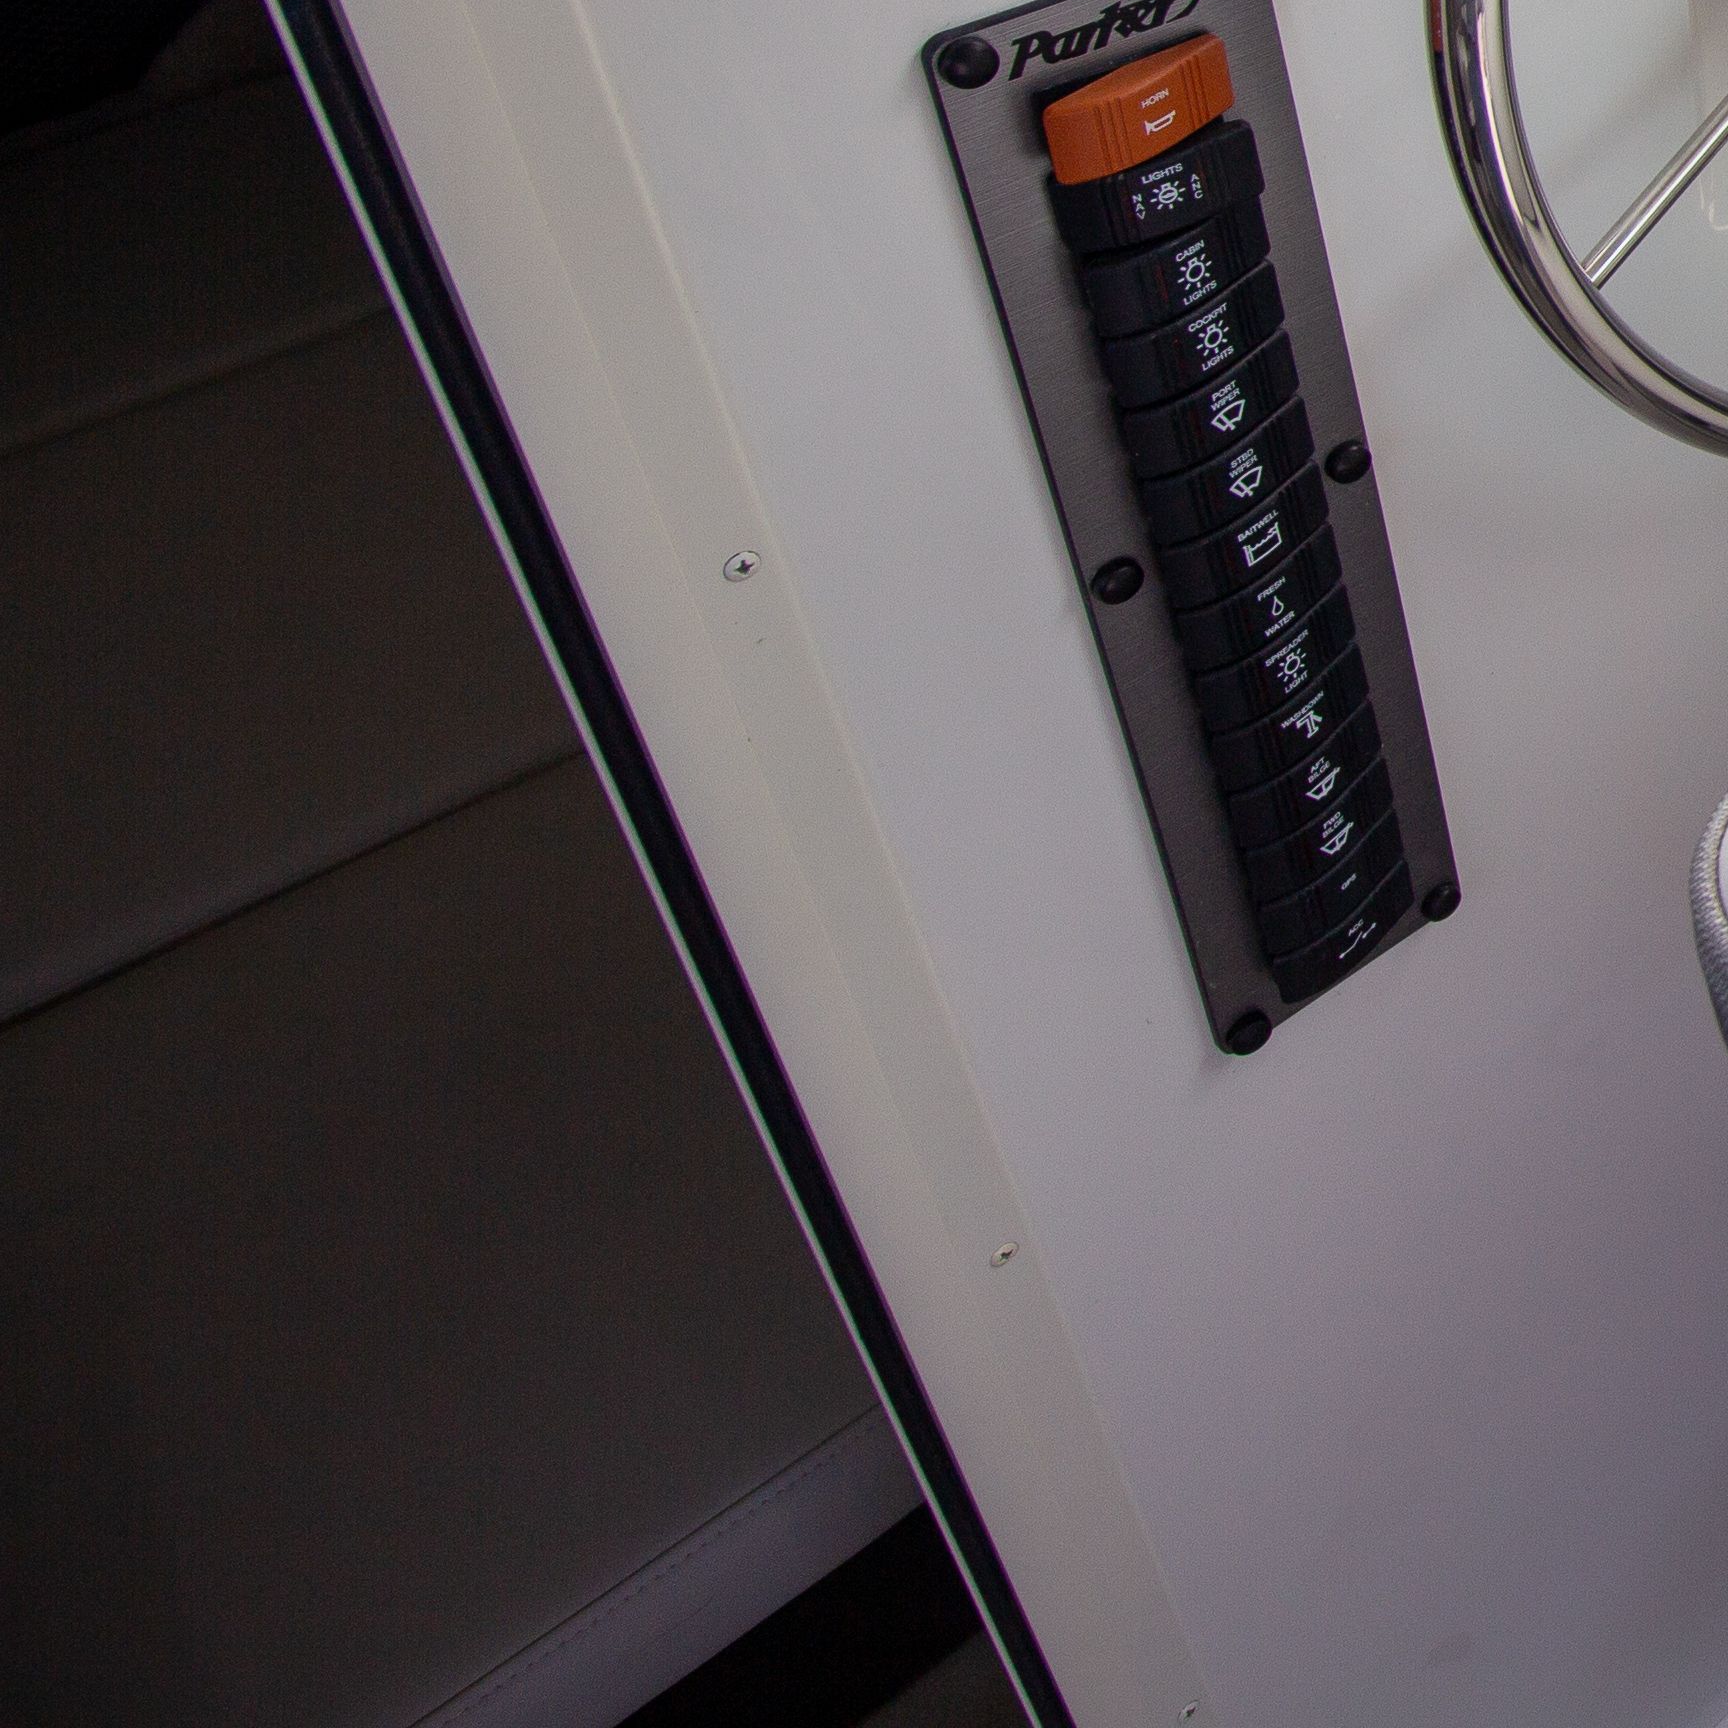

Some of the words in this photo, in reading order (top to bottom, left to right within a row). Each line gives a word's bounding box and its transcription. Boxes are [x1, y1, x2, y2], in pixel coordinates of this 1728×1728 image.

[1141, 88, 1169, 109] HORN
[1141, 163, 1183, 184] LIGHTS
[1191, 173, 1203, 199] ANC
[1132, 193, 1146, 220] NAV
[1175, 239, 1205, 262] CABIN
[1183, 280, 1217, 306] LIGHTS
[1188, 302, 1228, 332] COCKPIT
[1201, 345, 1234, 372] LIGHTS
[1210, 388, 1241, 411] WIPER
[1211, 379, 1237, 401] PORT
[1228, 454, 1258, 478] WIPER
[1230, 448, 1254, 469] STBD
[1237, 509, 1279, 543] BAITWELL
[1257, 576, 1286, 602] FRESH
[1264, 610, 1296, 638] WATER
[1265, 629, 1309, 667] SPREADER
[1284, 670, 1308, 694] LIGHT
[1281, 690, 1324, 729] WASHDOWN
[1308, 760, 1330, 784] BILGE
[1322, 815, 1345, 839] BILGE
[1348, 918, 1364, 937] ACC
